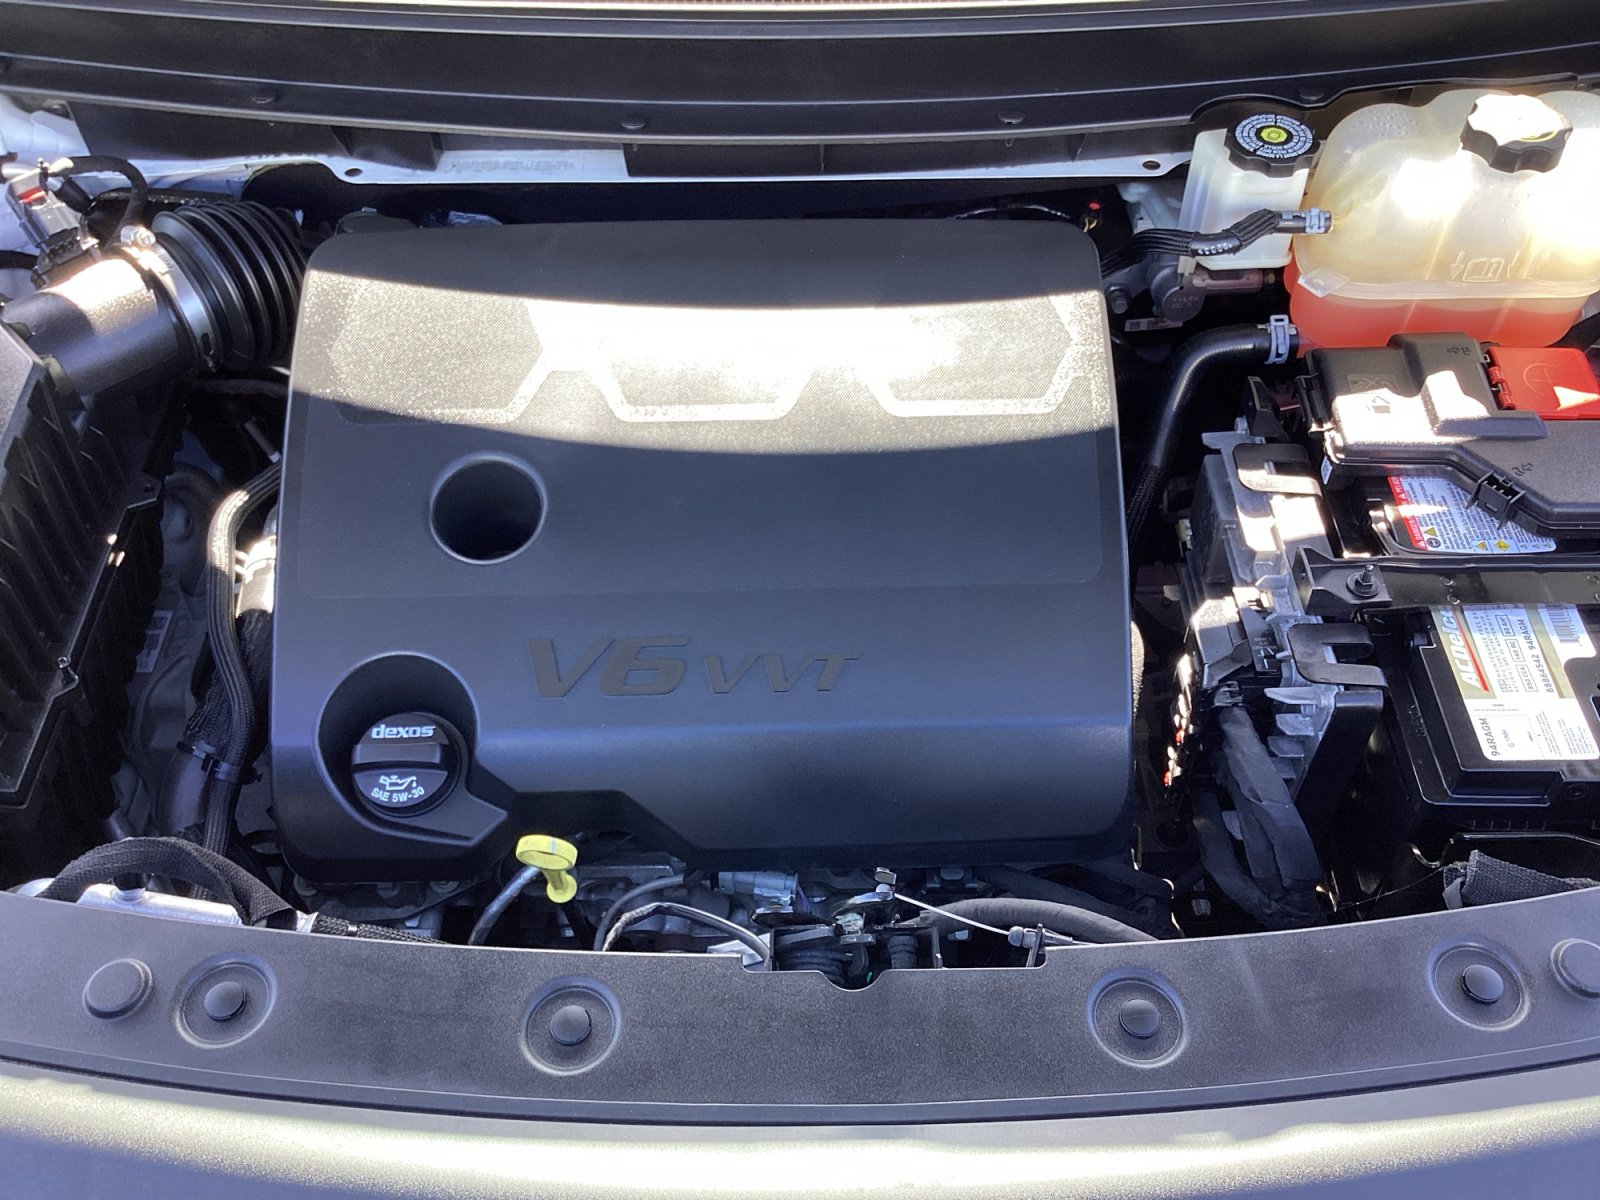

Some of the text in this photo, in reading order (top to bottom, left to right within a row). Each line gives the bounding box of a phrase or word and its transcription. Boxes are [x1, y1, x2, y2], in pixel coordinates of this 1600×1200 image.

[1517, 619, 1537, 651] 94RAGM
[1509, 640, 1521, 660] 140 RC
[528, 635, 860, 698] V6 VVT
[1519, 666, 1534, 690] 850 CCA
[1531, 653, 1554, 692] 88864542
[371, 724, 436, 739] dexos
[1478, 717, 1501, 757] 94RAGM
[371, 786, 425, 802] SAE 5W-30
